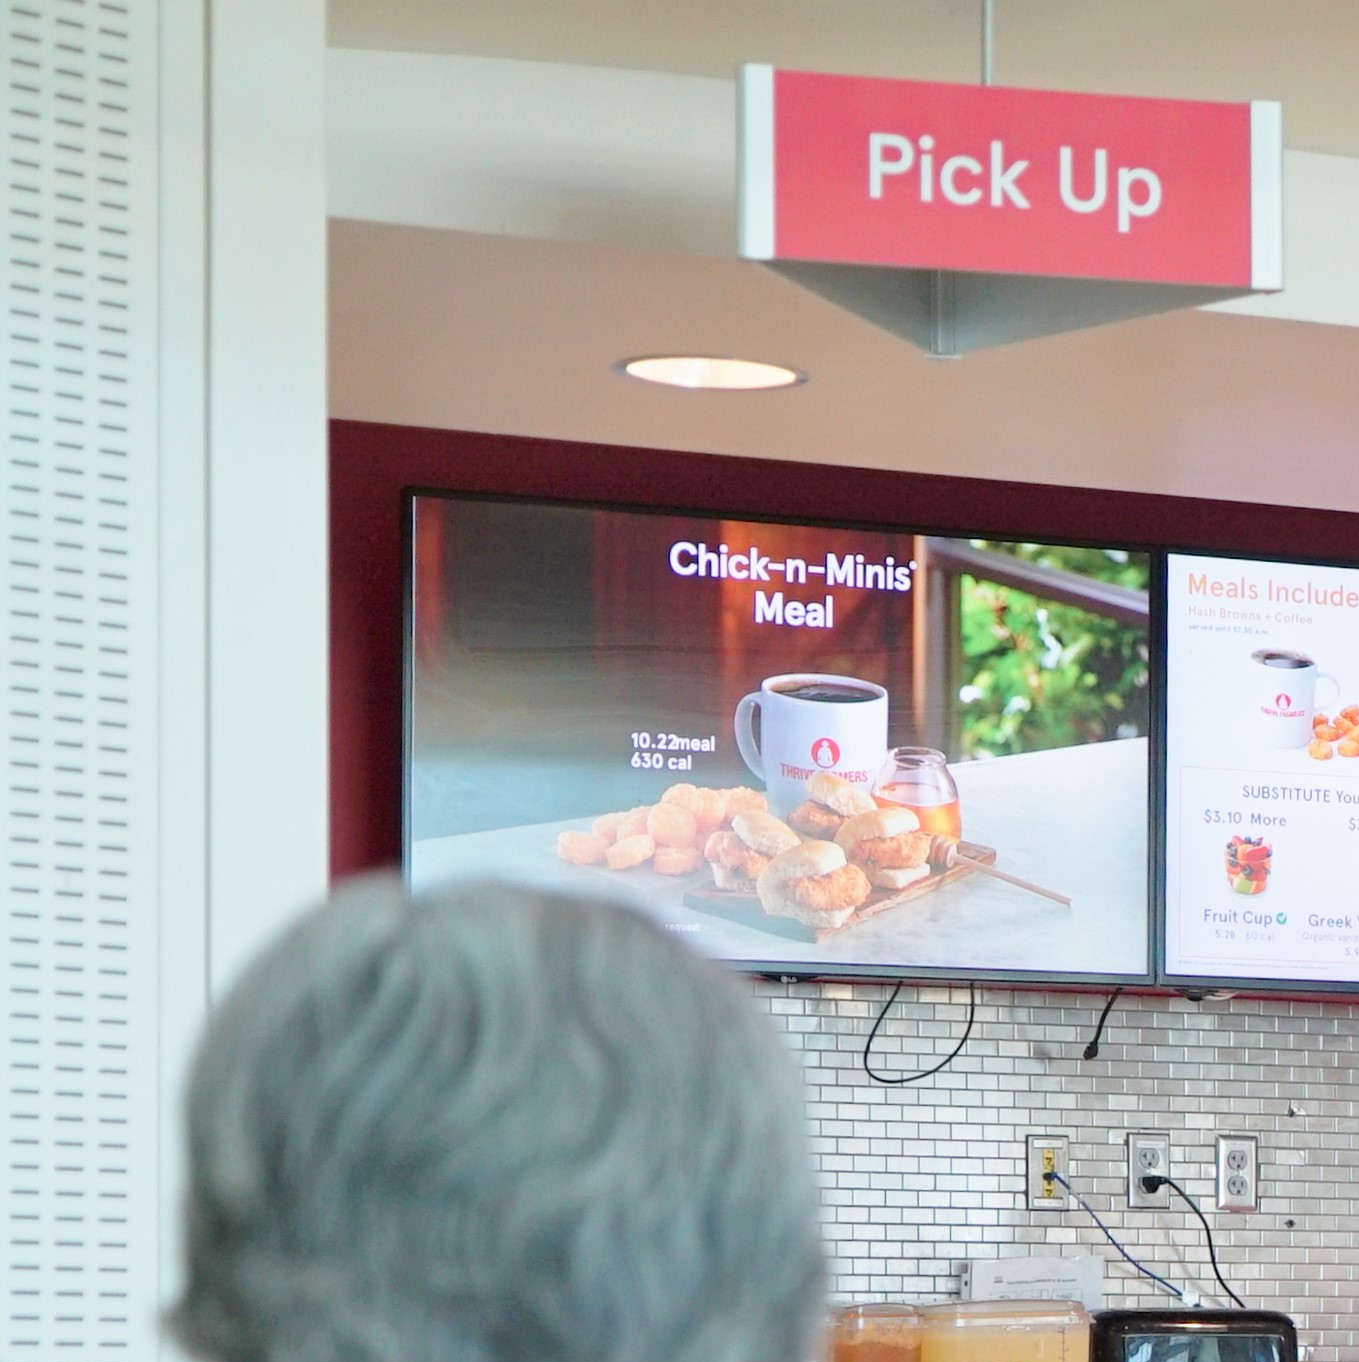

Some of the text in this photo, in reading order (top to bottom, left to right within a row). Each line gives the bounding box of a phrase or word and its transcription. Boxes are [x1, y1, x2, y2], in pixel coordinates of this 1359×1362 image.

[869, 131, 1162, 233] Pick Up
[1188, 573, 1359, 608] Meals Include
[754, 591, 834, 628] Meal
[1188, 605, 1216, 618] Hash
[1219, 607, 1261, 621] Browns
[1274, 612, 1313, 625] Coffee
[631, 752, 692, 771] 630 cal
[1242, 785, 1331, 803] SUBSTITUTE
[1204, 808, 1287, 827] $3.10 More
[1203, 908, 1273, 929] Fruit Cup
[1308, 913, 1352, 930] Greek
